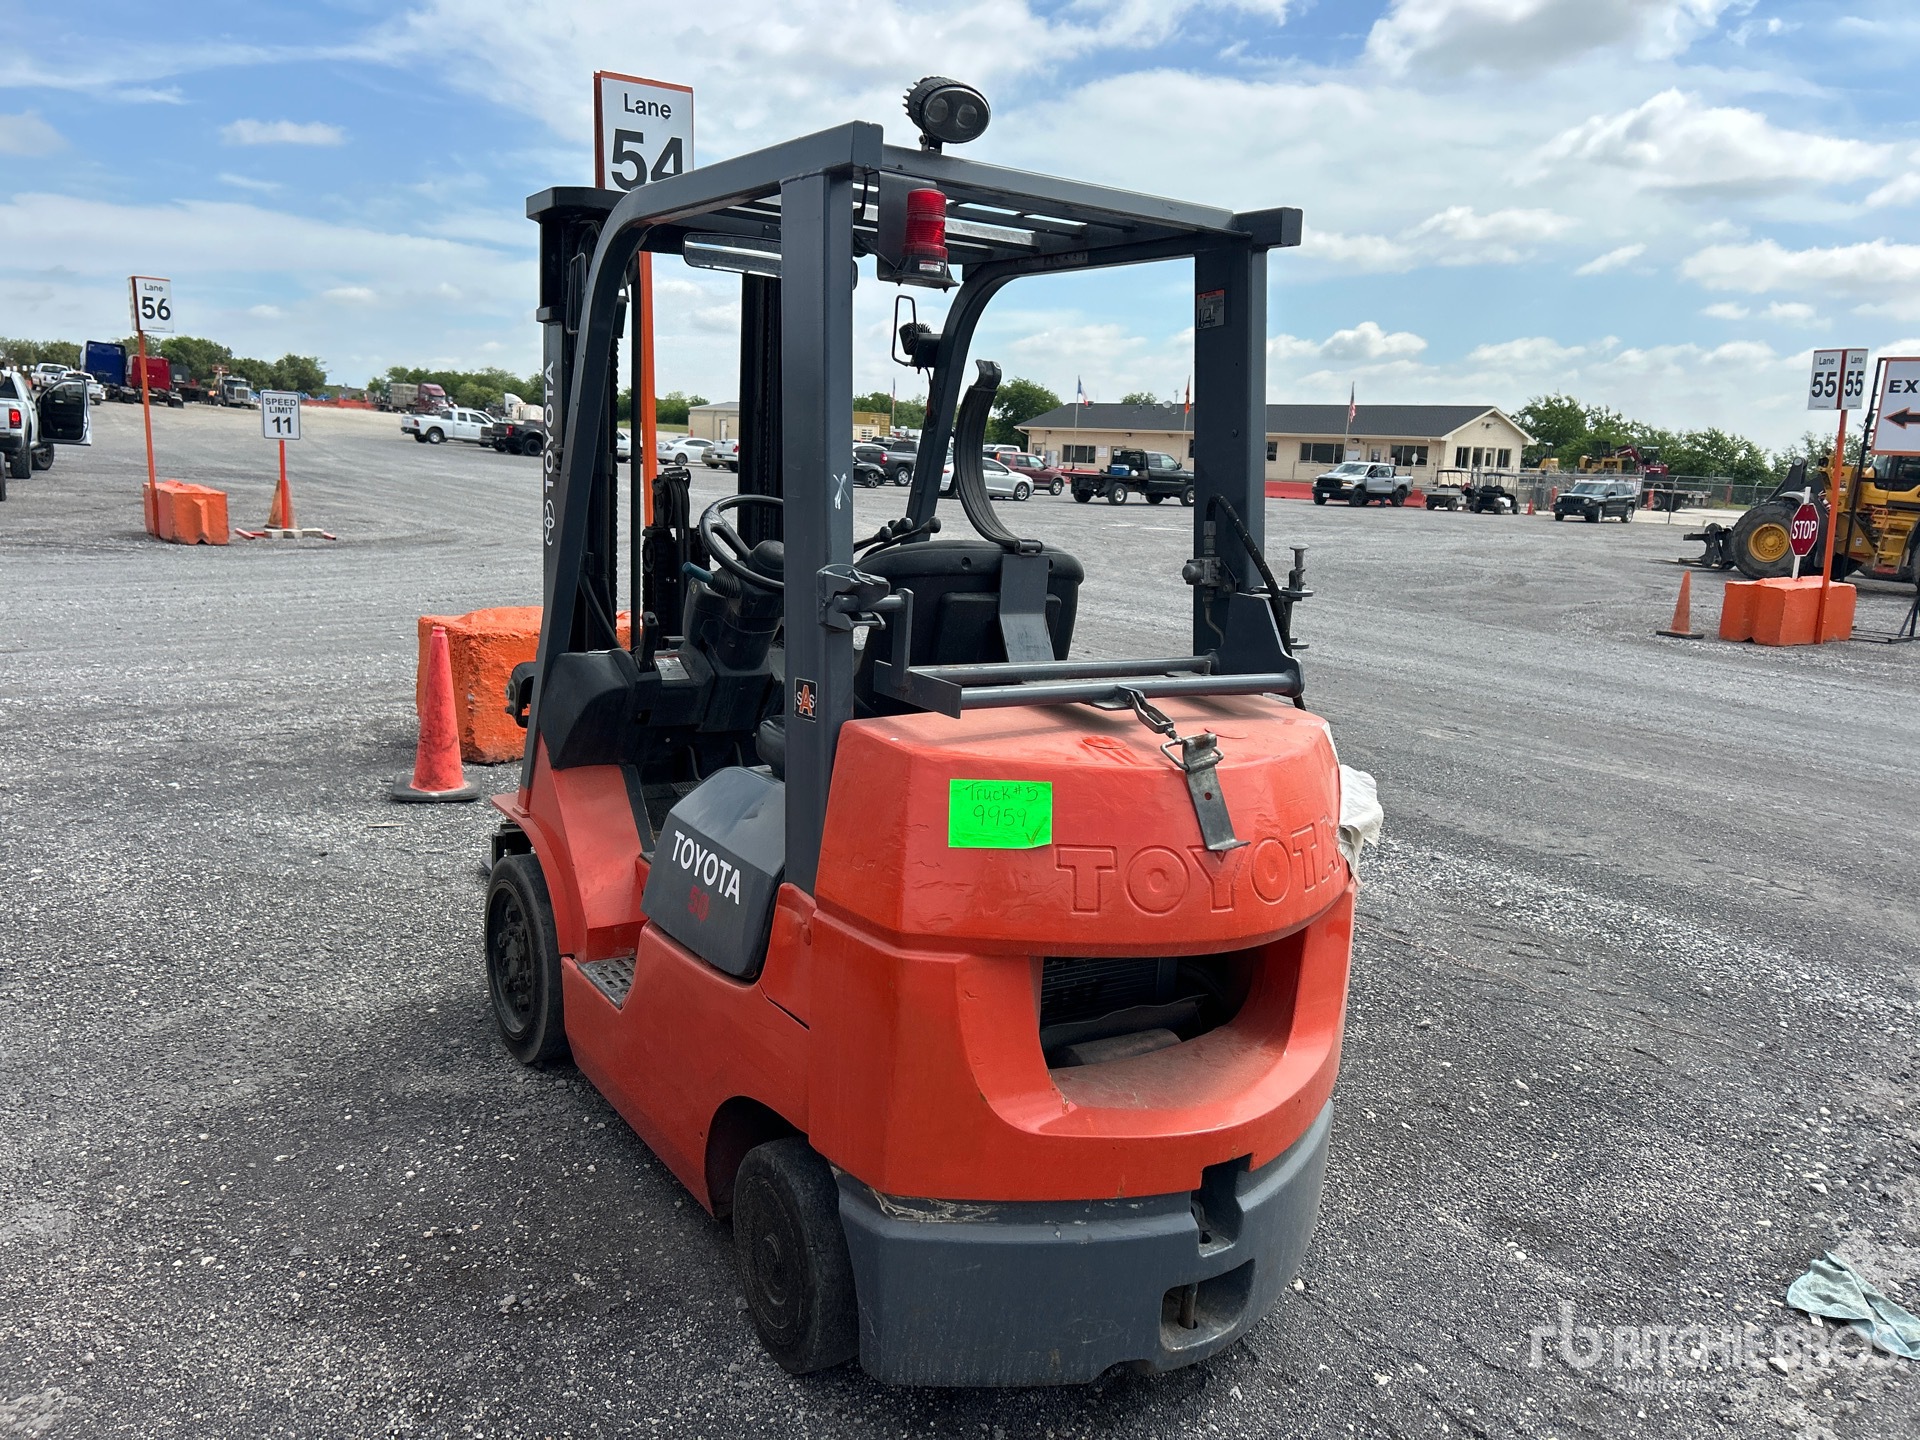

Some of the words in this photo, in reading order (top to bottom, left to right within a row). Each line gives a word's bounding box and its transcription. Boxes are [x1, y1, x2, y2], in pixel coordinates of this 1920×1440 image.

[623, 92, 672, 119] Lane
[611, 128, 683, 191] 54
[144, 283, 164, 292] Lane
[142, 296, 171, 320] 56
[1819, 357, 1836, 365] Lane
[1850, 355, 1864, 364] Lane
[1811, 371, 1838, 398] 55
[1844, 370, 1865, 397] 55
[265, 397, 297, 406] SPEED
[269, 406, 293, 414] LIMIT
[272, 416, 292, 434] 11
[544, 360, 554, 494] TOYOTA
[1792, 520, 1817, 540] STOP
[973, 804, 1027, 827] 9959
[672, 829, 742, 905] TOYOTA
